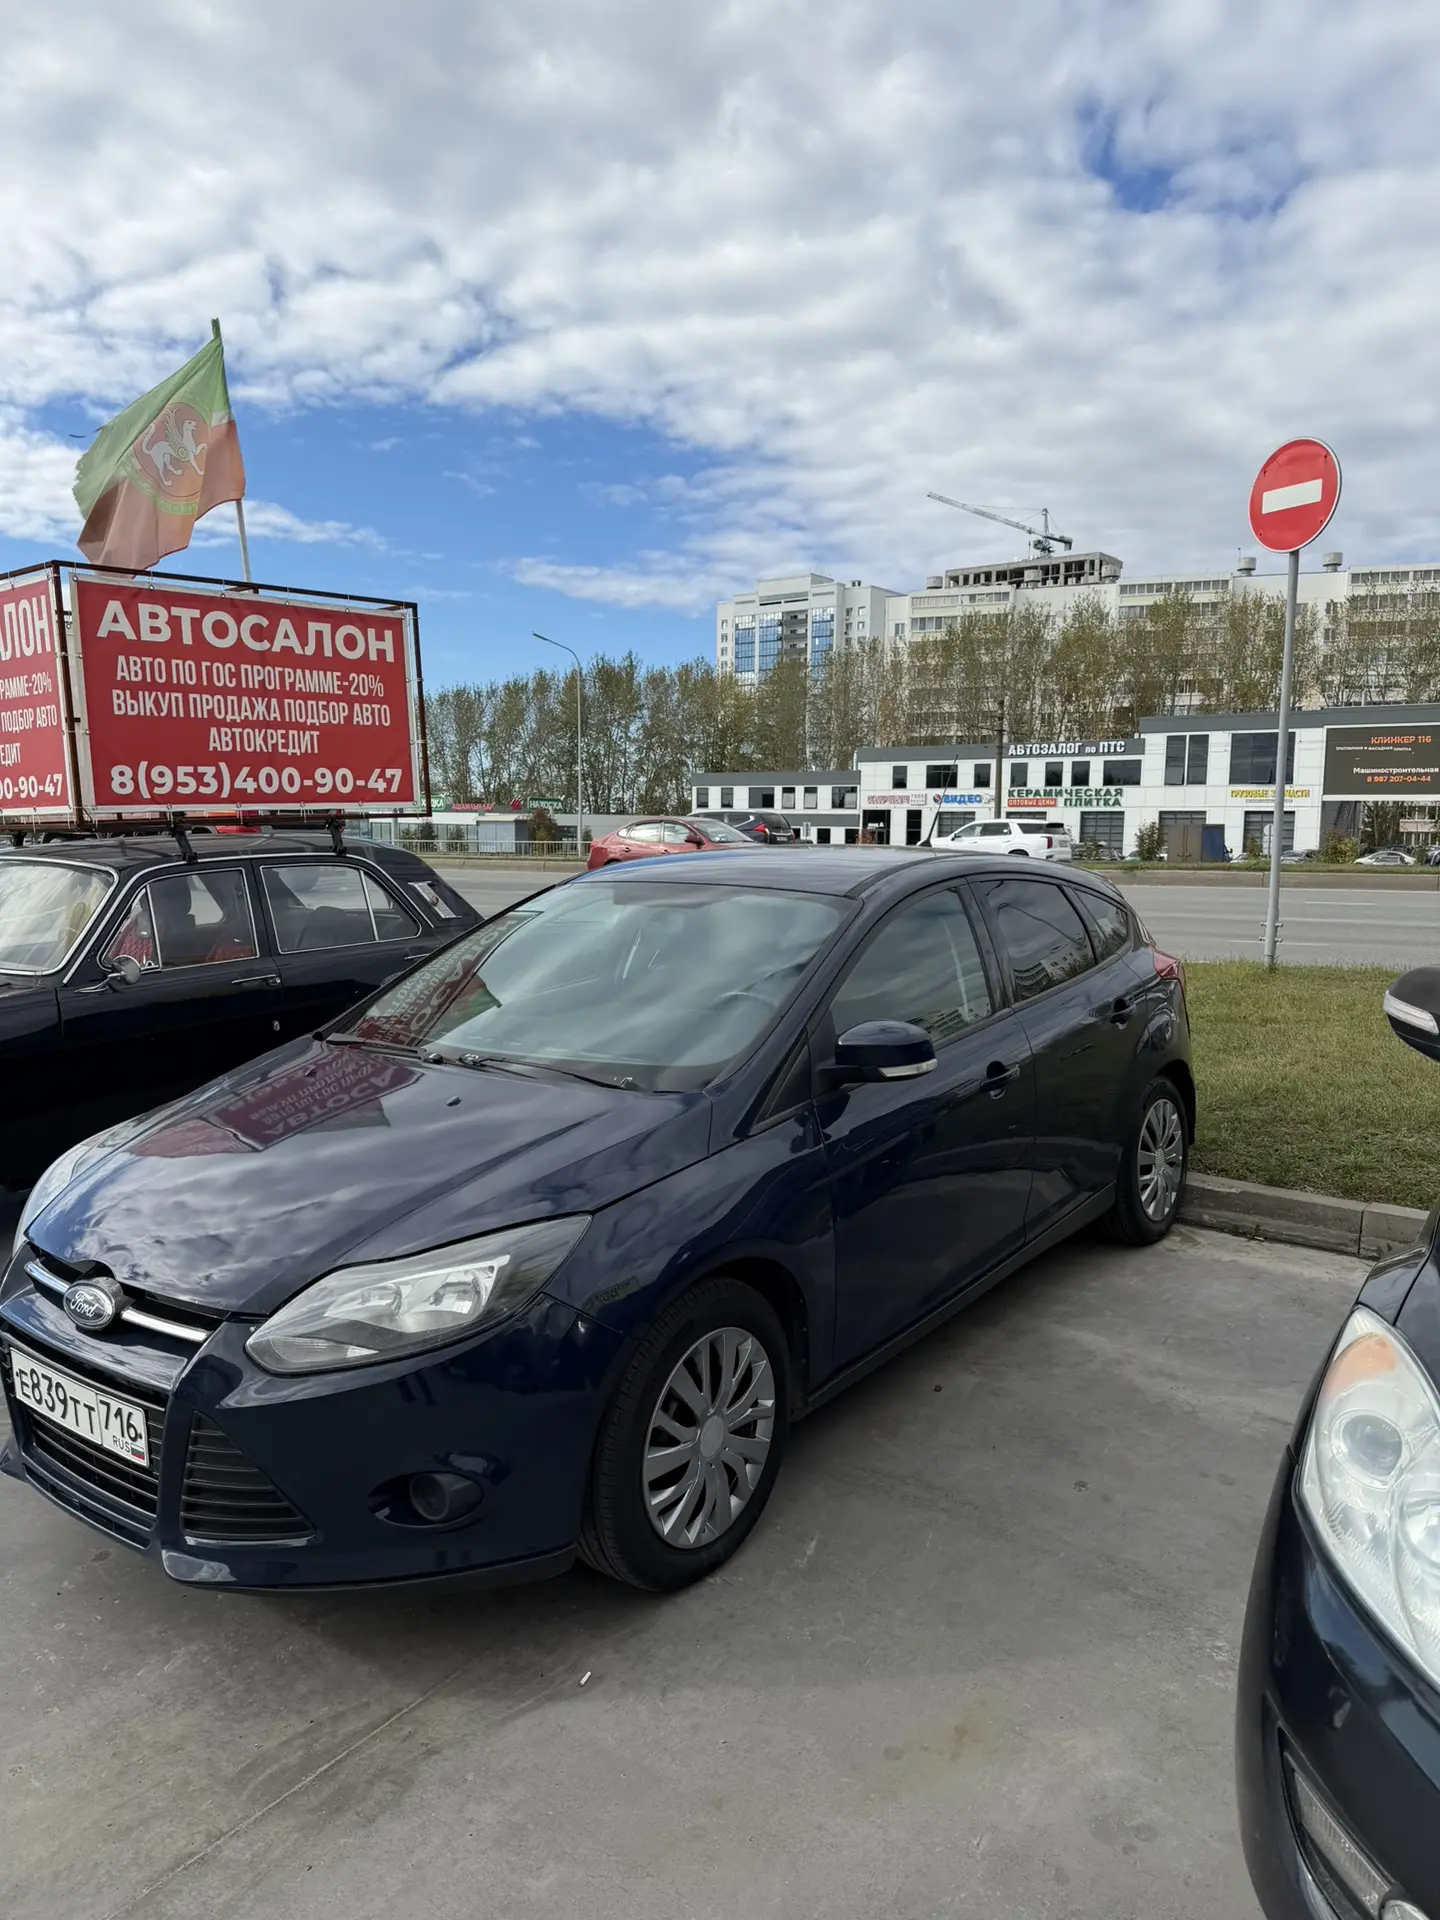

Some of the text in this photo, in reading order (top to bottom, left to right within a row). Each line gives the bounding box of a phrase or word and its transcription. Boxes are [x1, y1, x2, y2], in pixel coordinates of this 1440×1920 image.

[97, 600, 395, 663] АВТОСАЛОН
[116, 655, 384, 698] АВТО ПО ГОС ПРОГРАММЕ-20%
[0, 704, 58, 734] ПОДБОР АВТО
[112, 689, 391, 727] ВЫКУП ПРОДАЖА ПОДБОР АВТО
[208, 727, 320, 756] АВТОКРЕДИТ
[1008, 741, 1126, 756] АВТОЗАЛОГ по ПТС
[1370, 735, 1432, 744] КЛИНКЕР 116
[110, 760, 402, 799] 8(953)400-90-47
[1353, 767, 1440, 775] Машиностроительная
[1389, 775, 1431, 783] 207-04-44
[1008, 788, 1124, 798] КЕРАМИЧЕСКАЯ
[1064, 798, 1122, 807] ПЛИТКА
[69, 1290, 99, 1318] Ford
[18, 1367, 139, 1443] Е839ТТ 716
[112, 1434, 131, 1450] RUS
